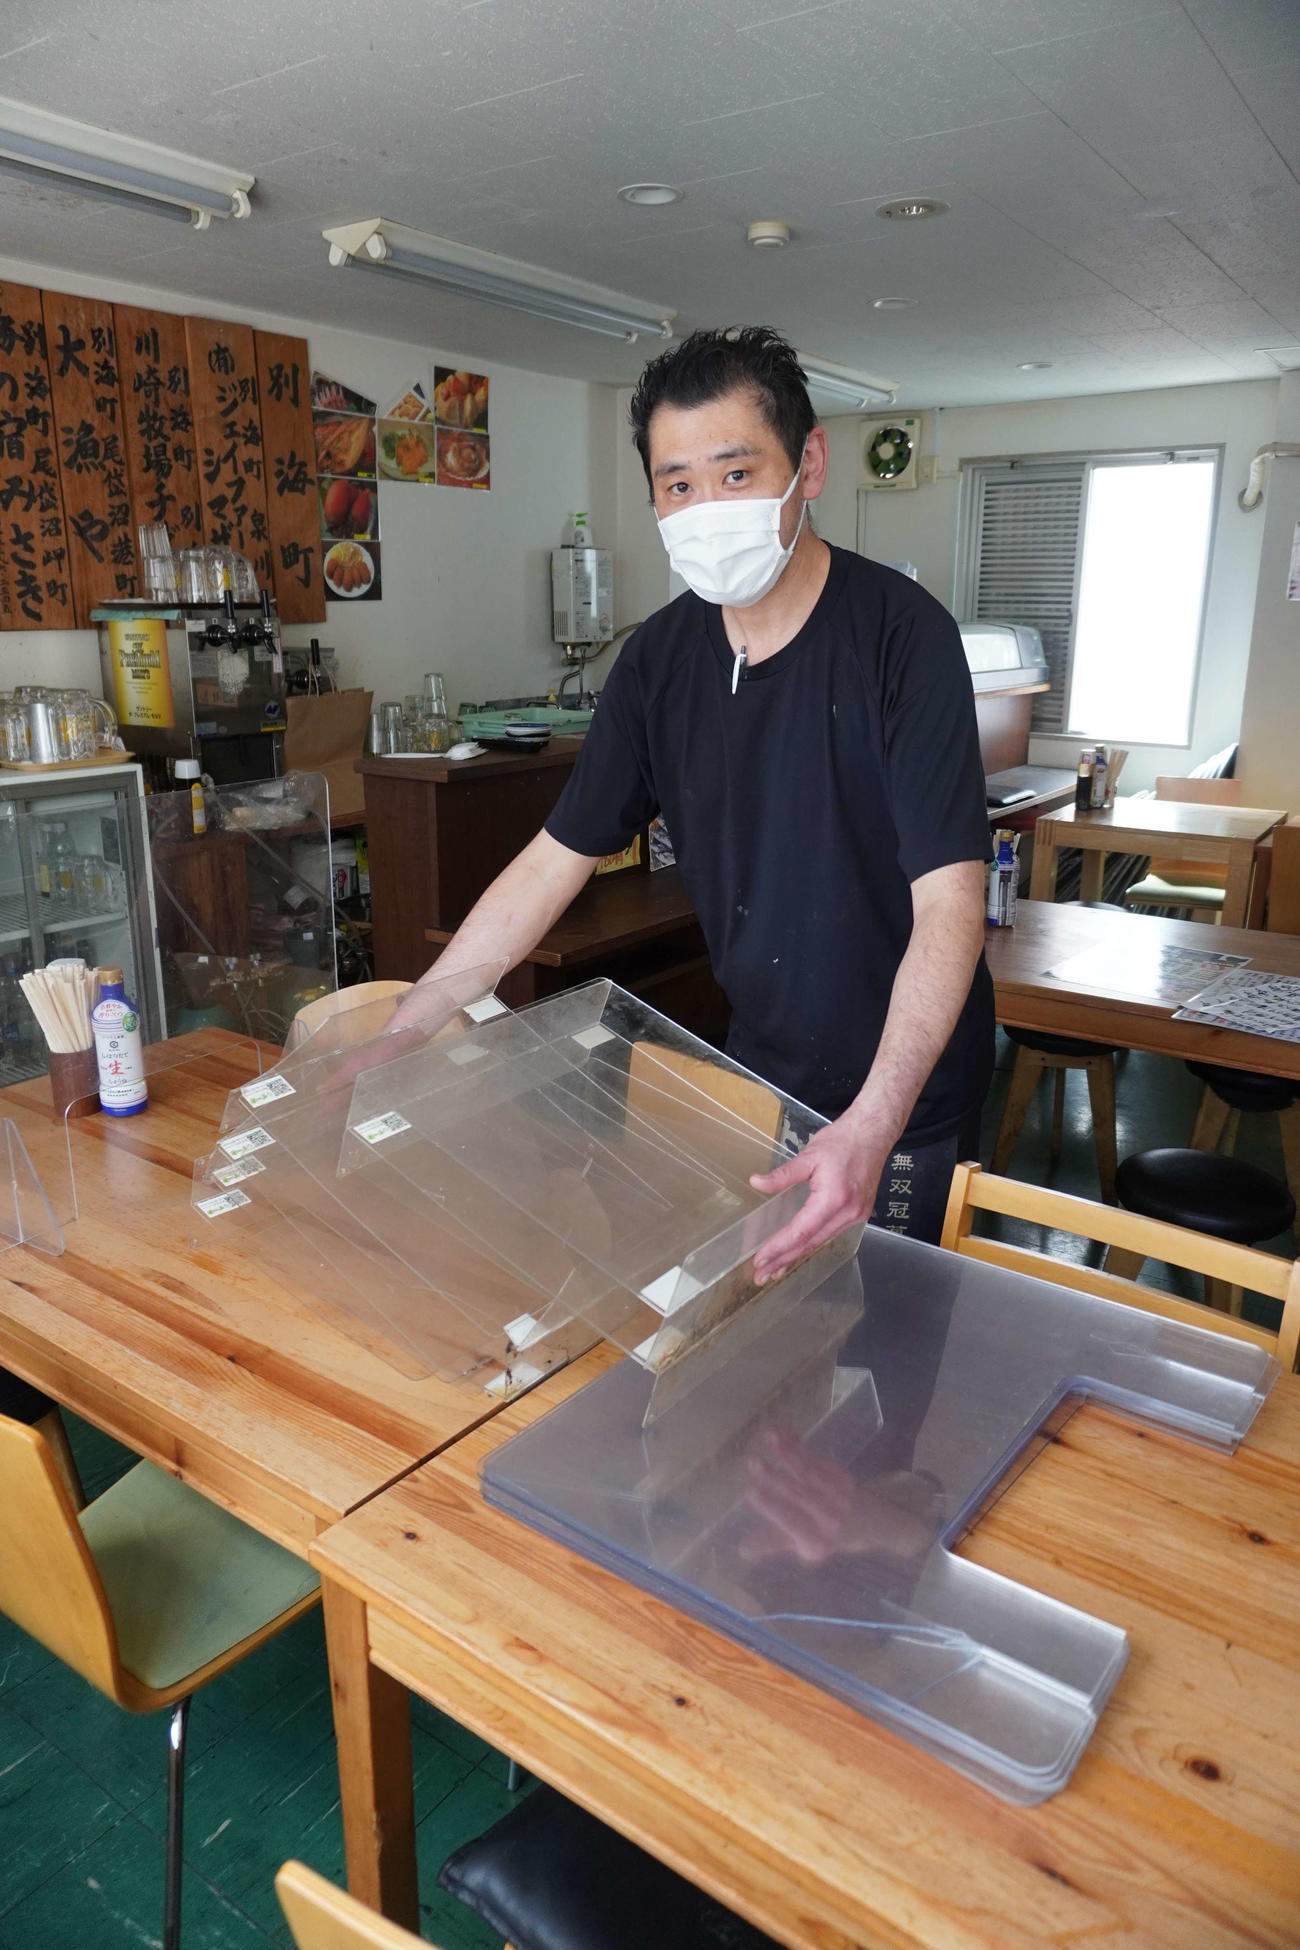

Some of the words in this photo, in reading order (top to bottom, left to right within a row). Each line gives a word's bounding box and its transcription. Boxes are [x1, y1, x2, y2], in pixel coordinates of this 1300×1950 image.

[56, 324, 110, 564] 大漁や
[133, 328, 179, 541] 川崎牧場チ
[203, 447, 233, 547] シマザ
[267, 363, 315, 589] 別海町
[108, 1060, 124, 1075] 生
